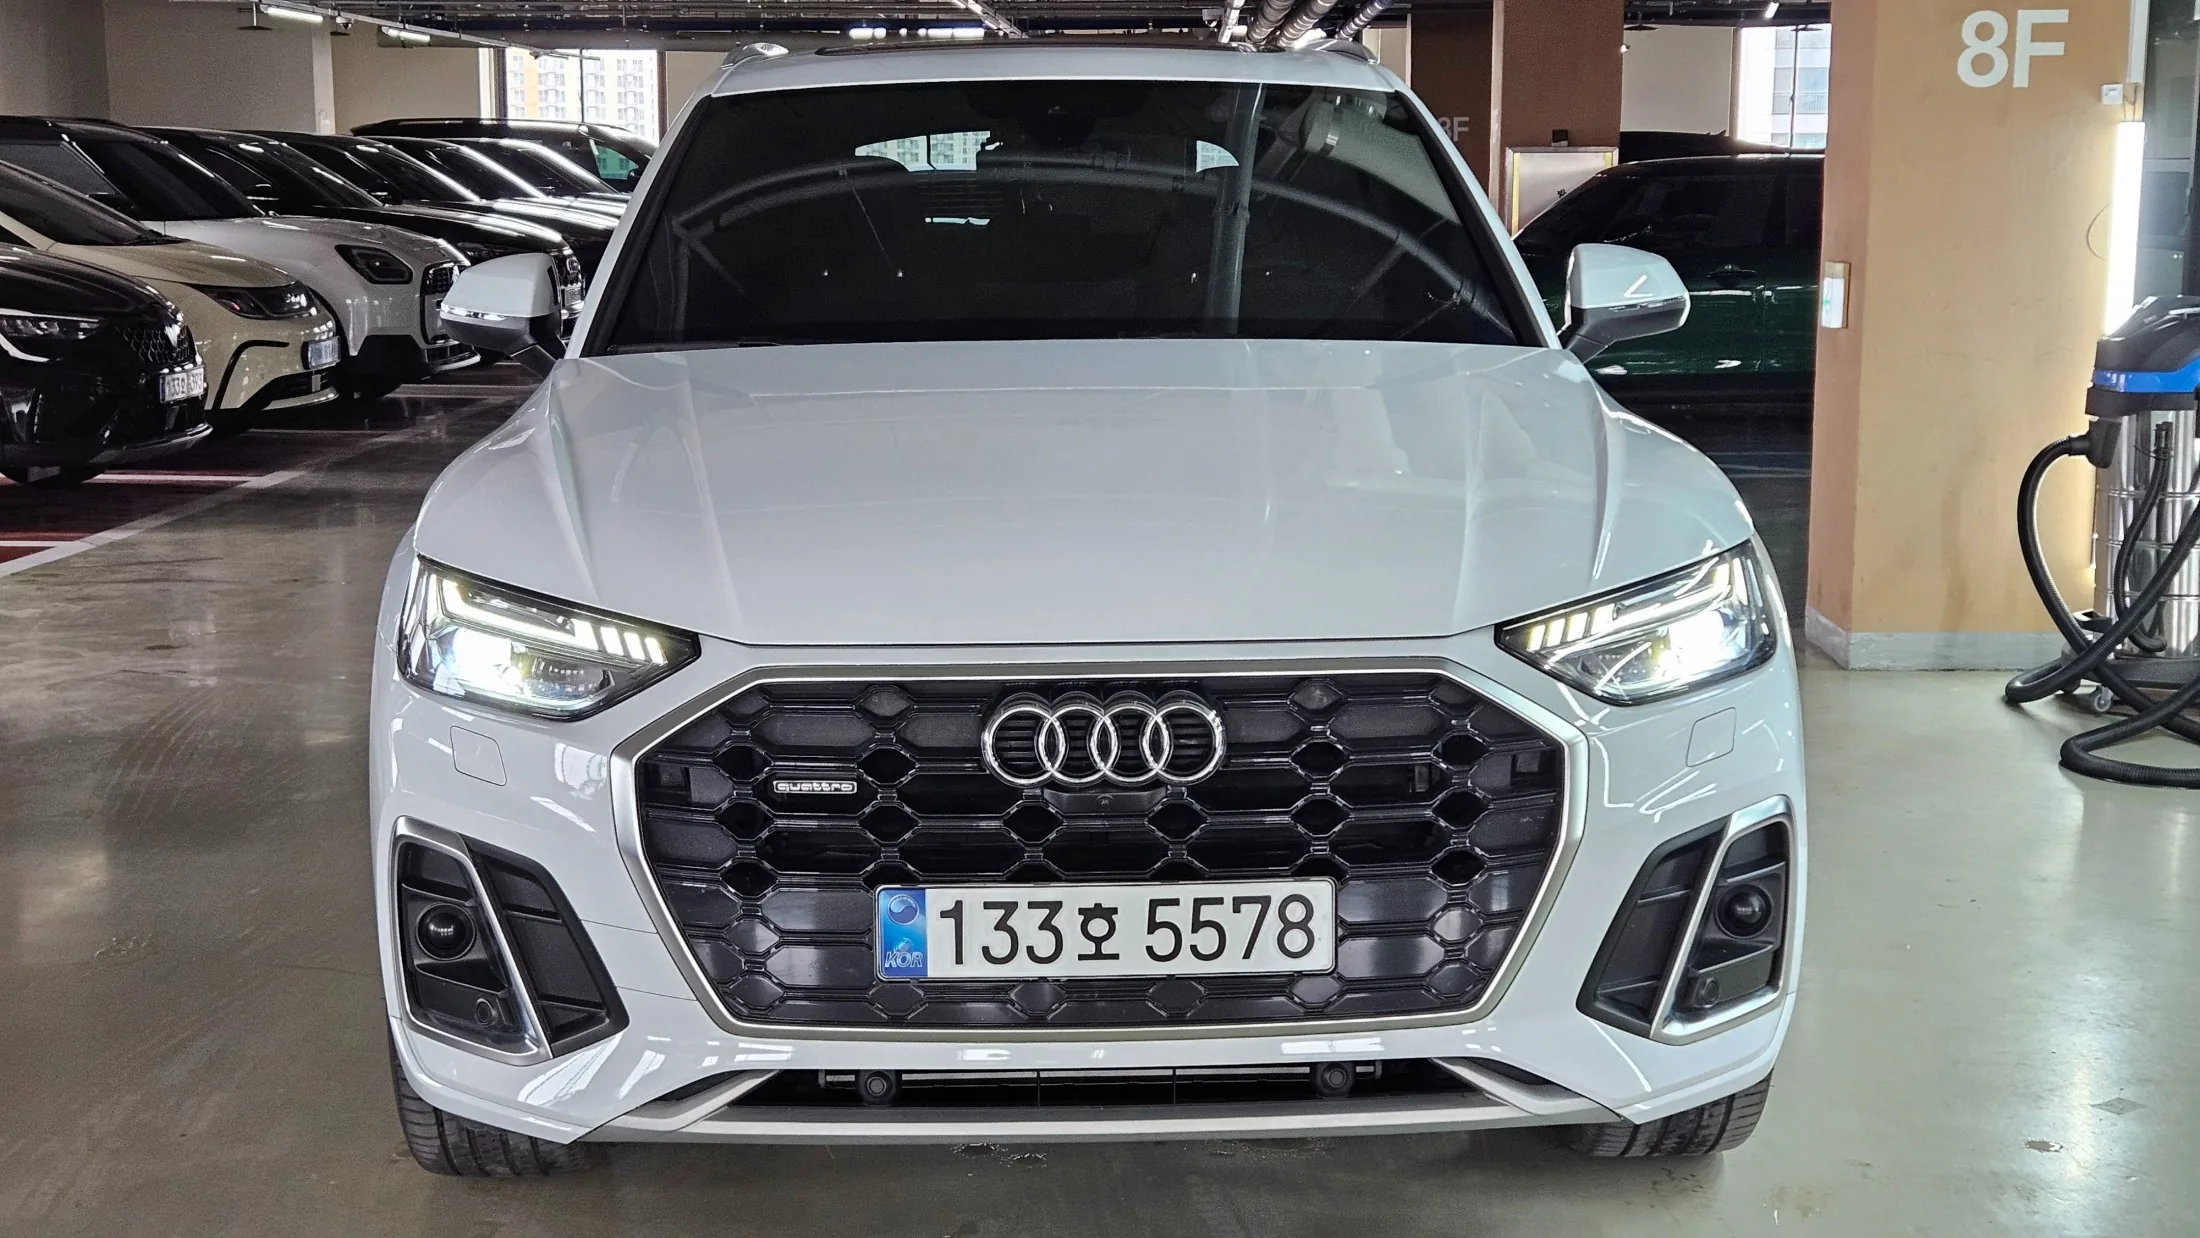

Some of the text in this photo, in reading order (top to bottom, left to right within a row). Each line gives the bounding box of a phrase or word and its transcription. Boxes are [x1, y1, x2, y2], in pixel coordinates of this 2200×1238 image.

[1957, 9, 2069, 88] 8F
[777, 782, 853, 792] quattro
[939, 893, 1315, 965] 133호 5578
[884, 951, 923, 968] KOR
